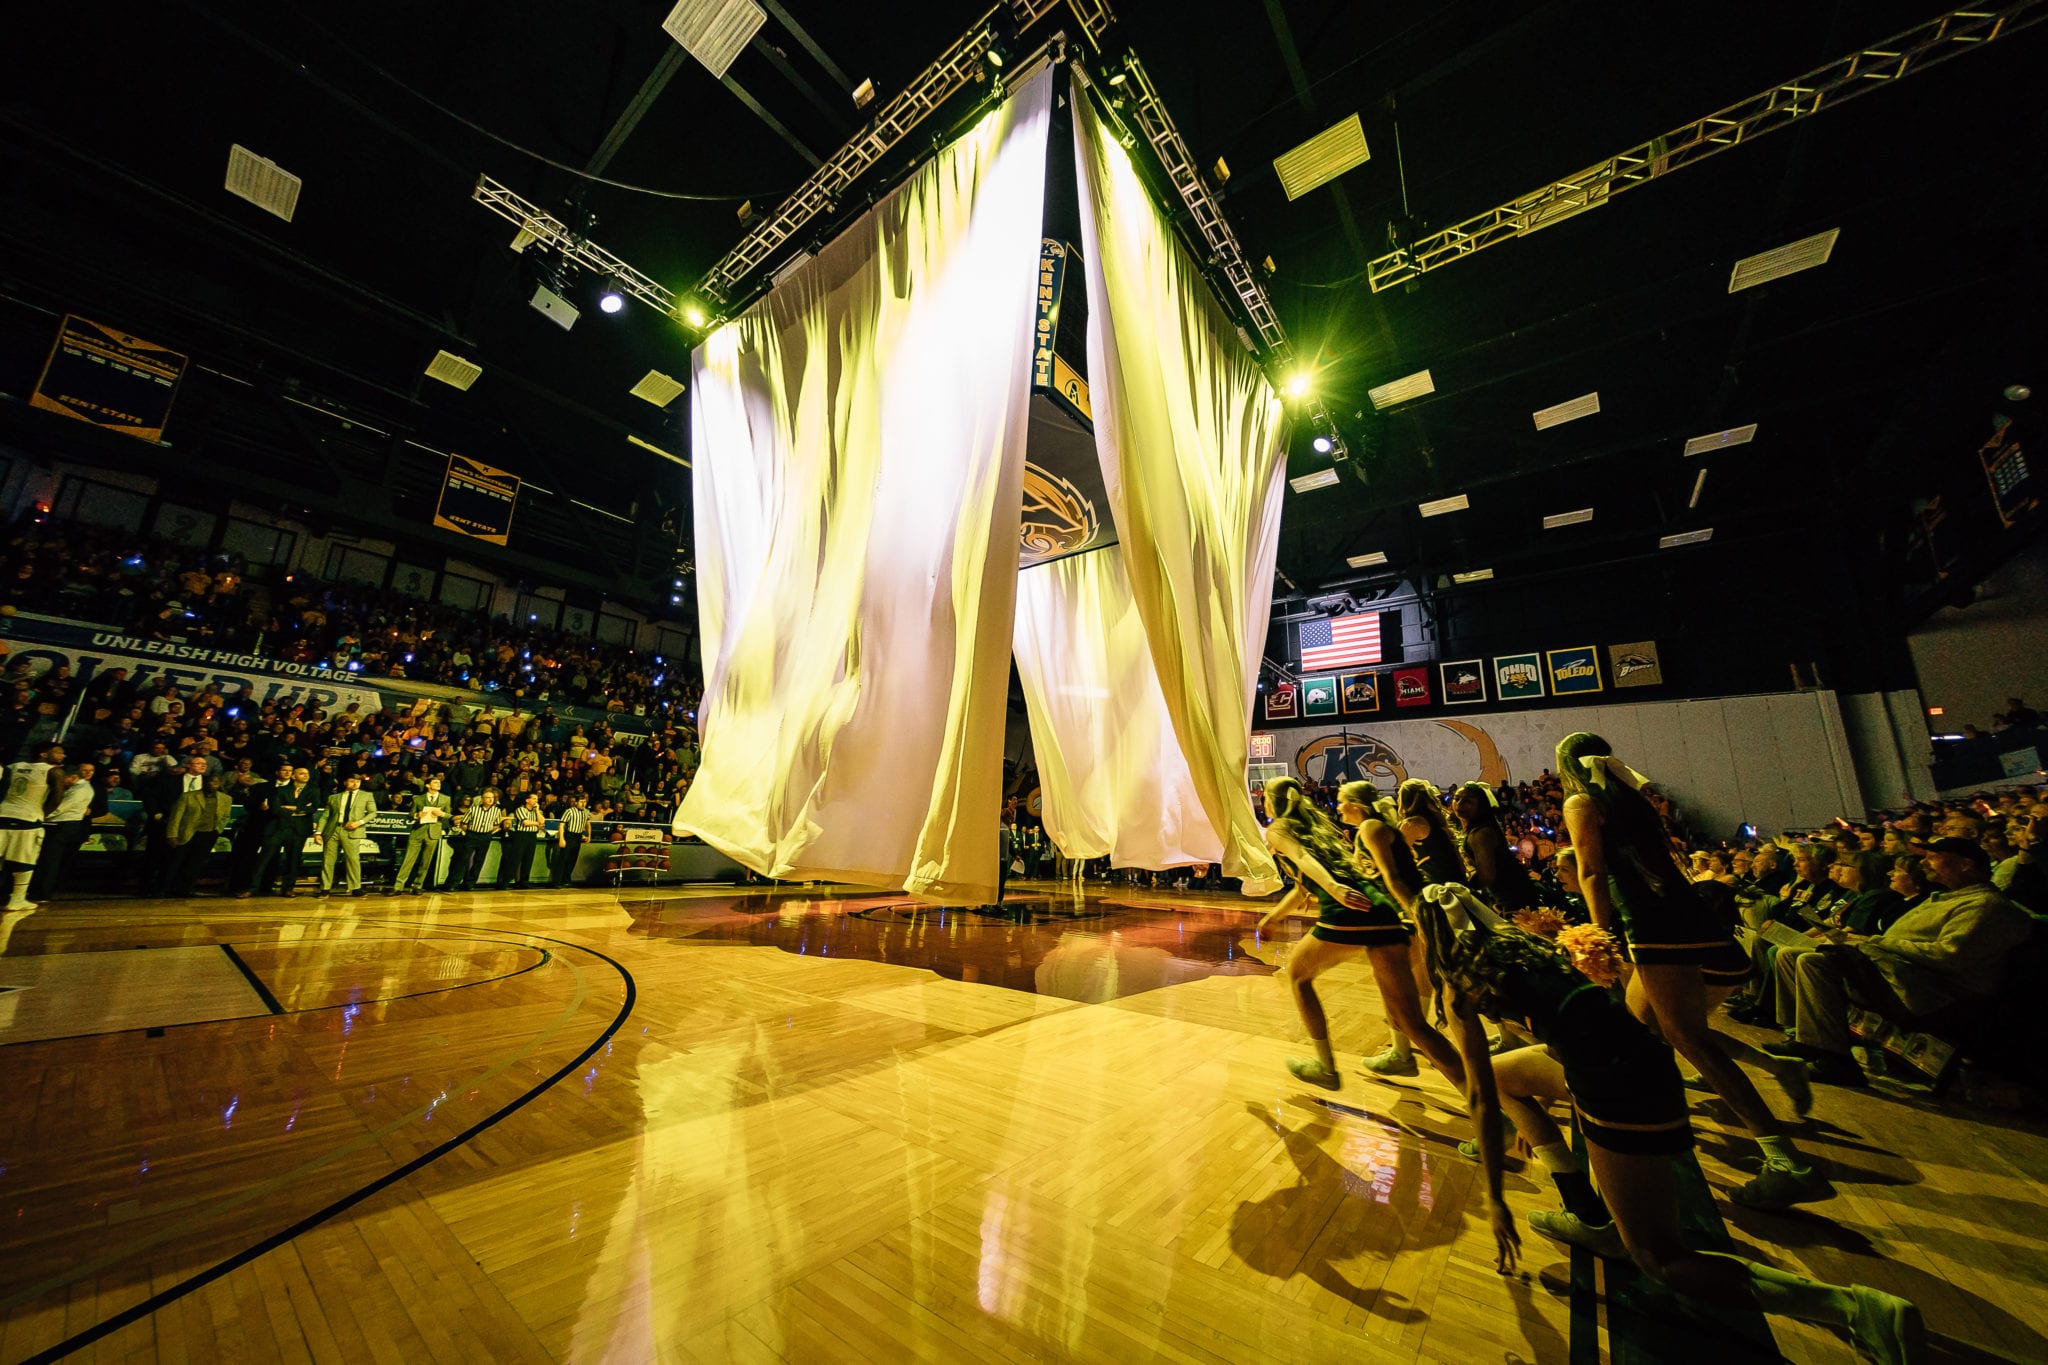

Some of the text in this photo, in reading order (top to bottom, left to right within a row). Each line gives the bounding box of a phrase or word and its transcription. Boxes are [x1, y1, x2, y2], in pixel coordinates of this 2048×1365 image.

[1036, 258, 1055, 386] KENT STATE
[92, 633, 359, 683] UNLEASH HIGH VOLTAGE
[1500, 662, 1538, 685] OHIO
[1554, 664, 1595, 681] TOLEDO
[1401, 686, 1425, 695] MIAMI
[1251, 736, 1271, 746] 20:00
[1255, 744, 1270, 756] 30
